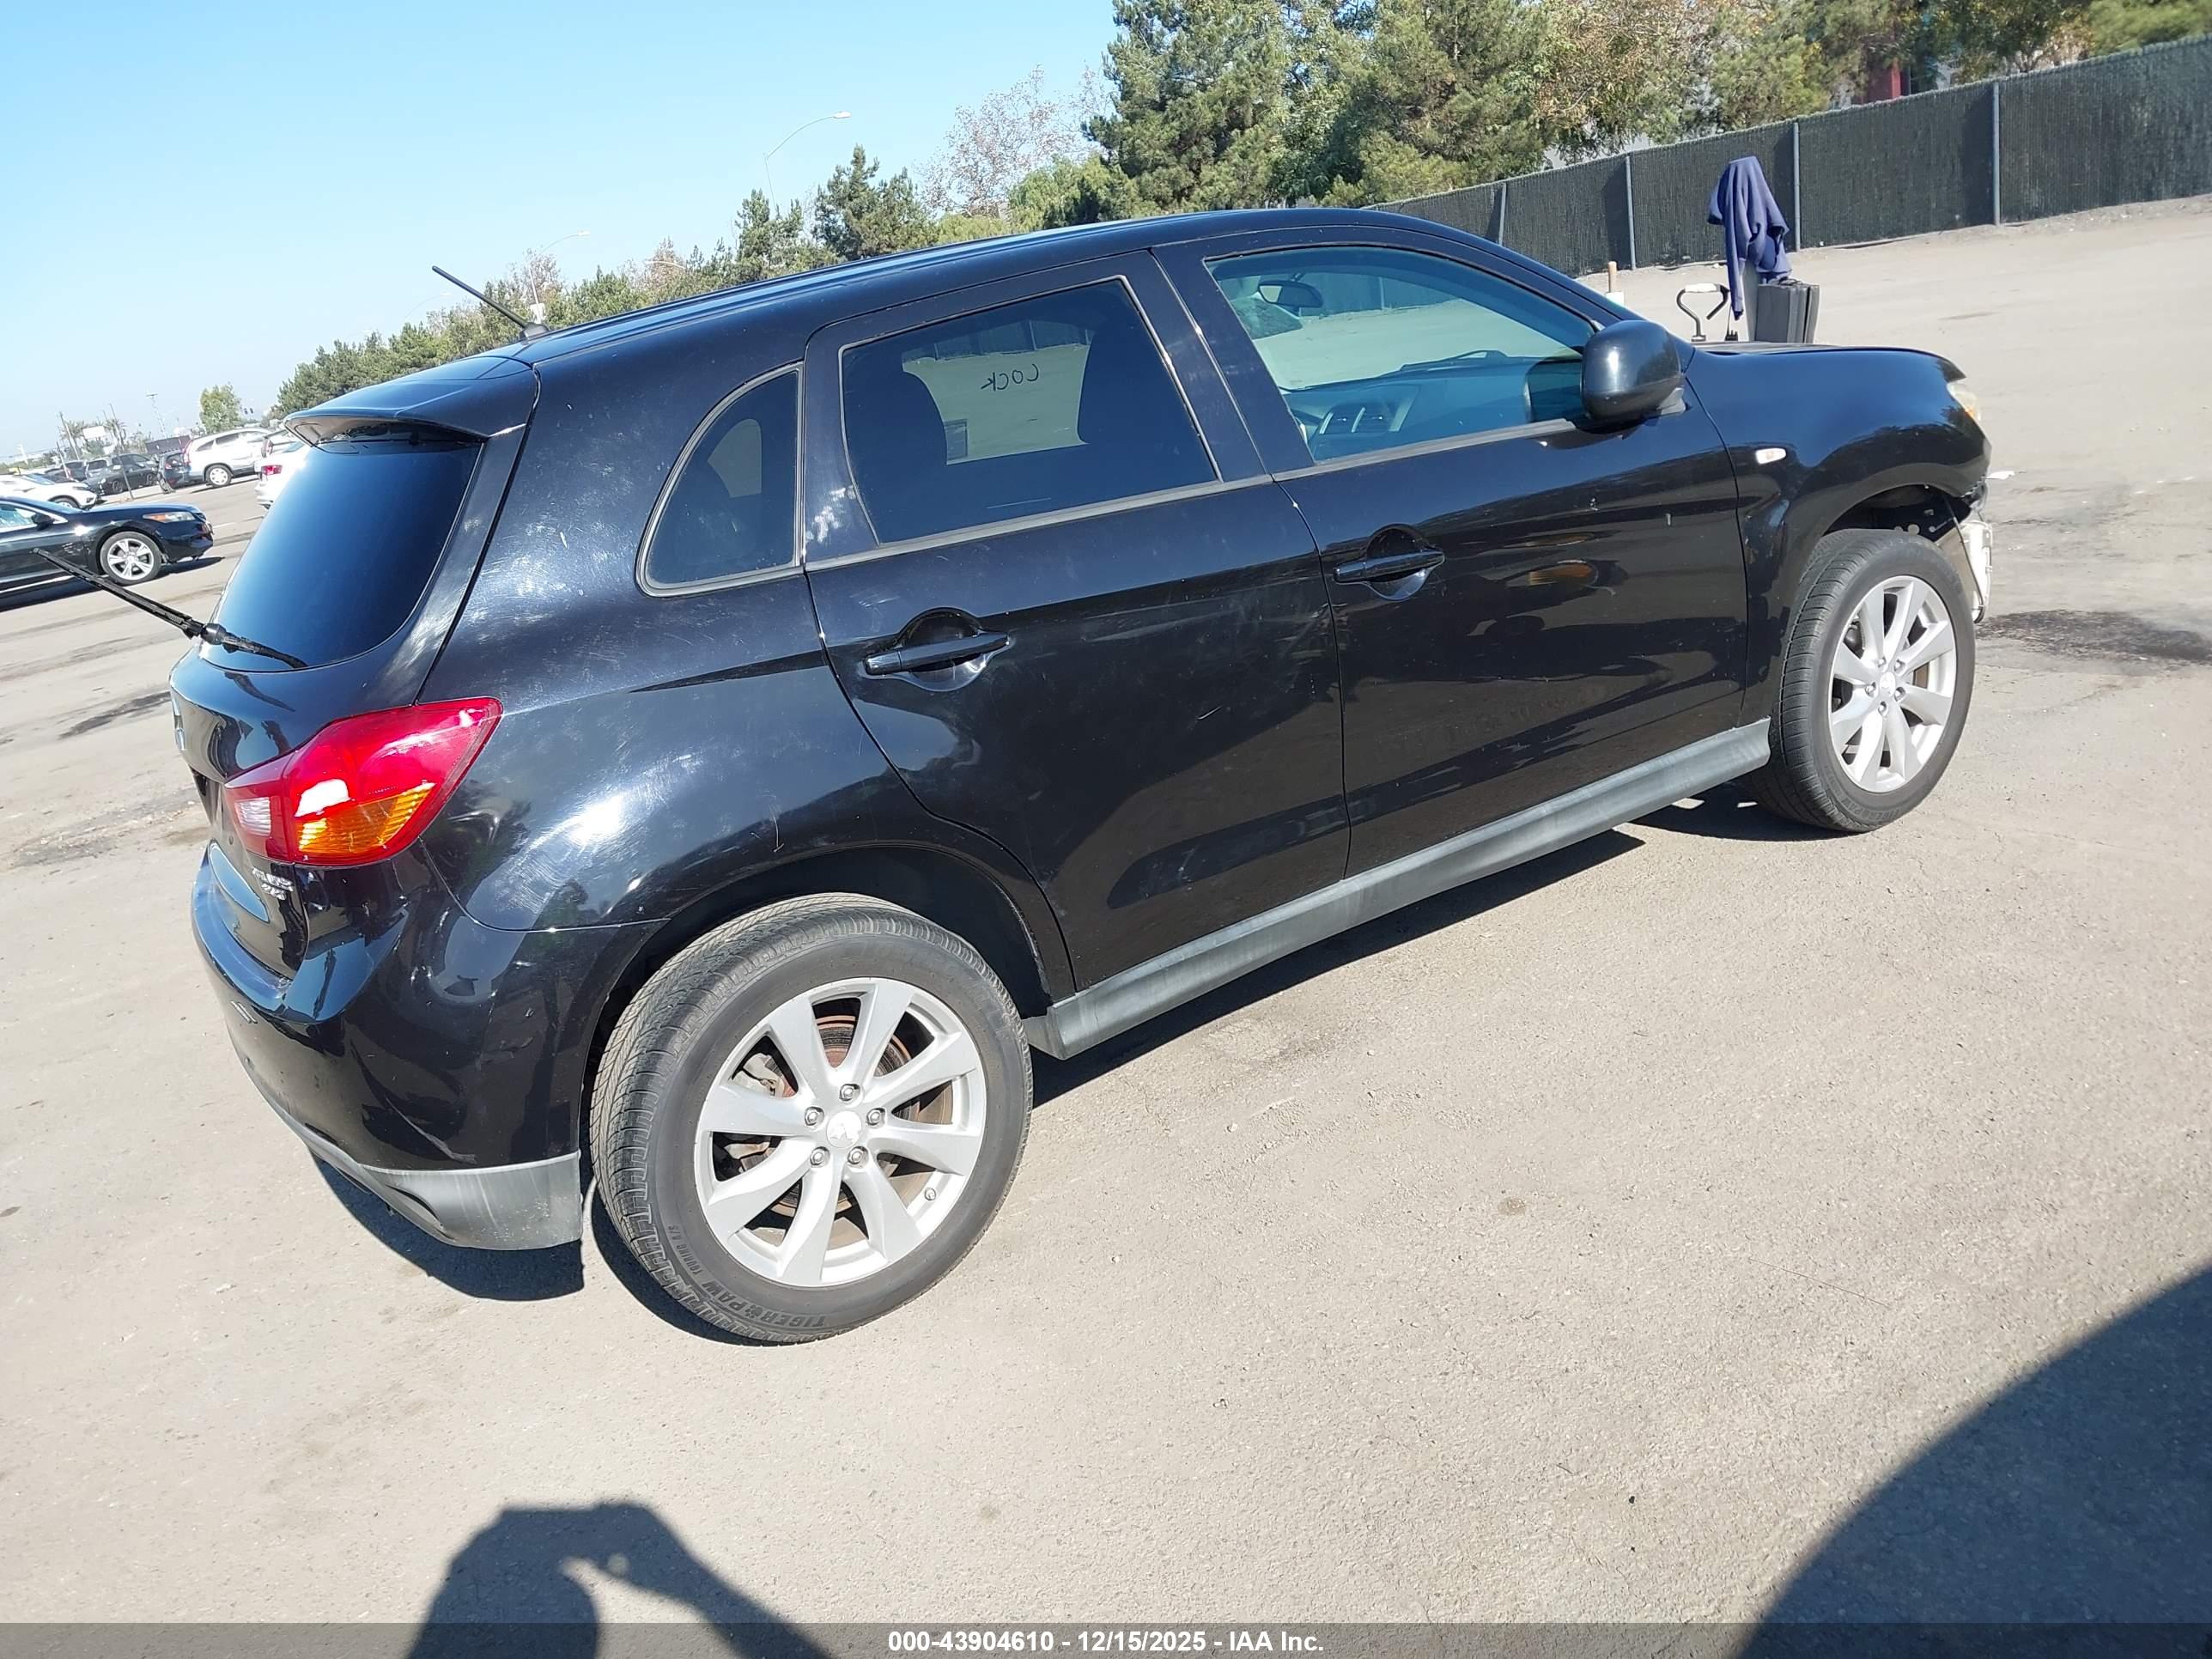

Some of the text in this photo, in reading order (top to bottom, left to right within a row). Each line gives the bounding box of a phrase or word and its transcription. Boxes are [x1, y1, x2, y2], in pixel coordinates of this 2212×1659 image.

[677, 1245, 703, 1274] TOURING
[702, 1281, 825, 1327] TIGER PAW
